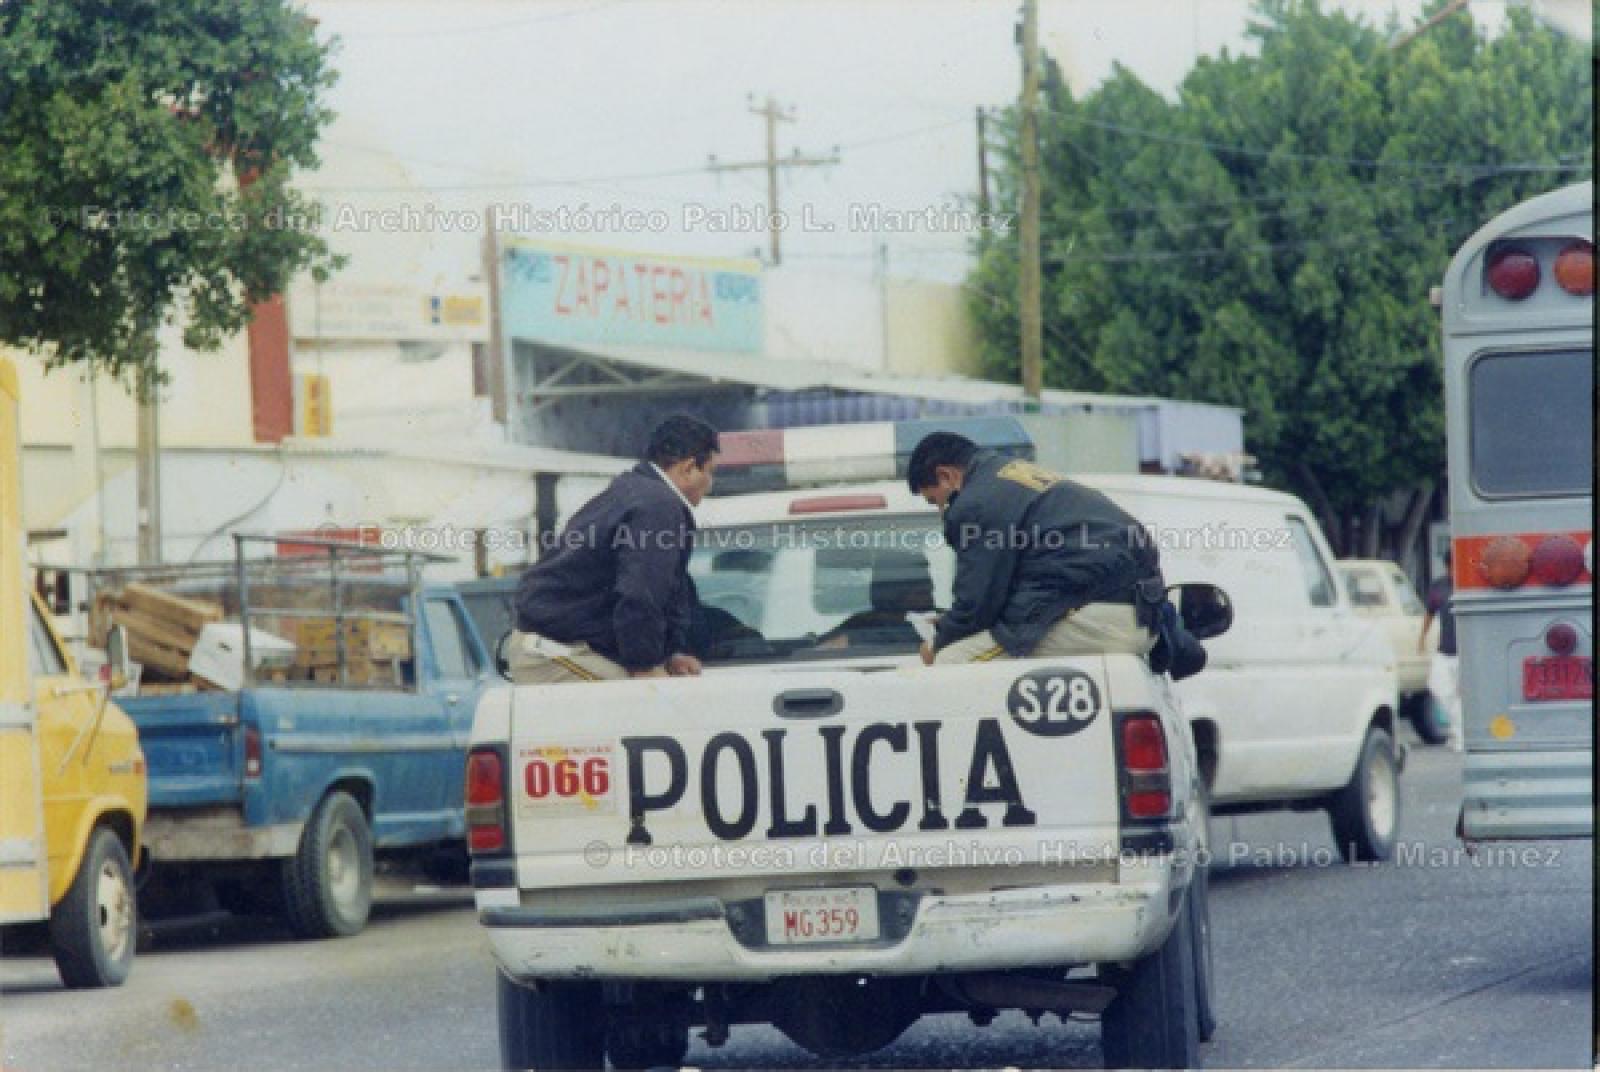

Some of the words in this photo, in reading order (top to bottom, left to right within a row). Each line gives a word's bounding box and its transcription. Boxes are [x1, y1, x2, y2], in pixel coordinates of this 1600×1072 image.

[553, 255, 714, 328] ZAPATERIA
[525, 756, 609, 798] 066
[621, 718, 1037, 844] POLICIA
[783, 907, 859, 937] MG359
